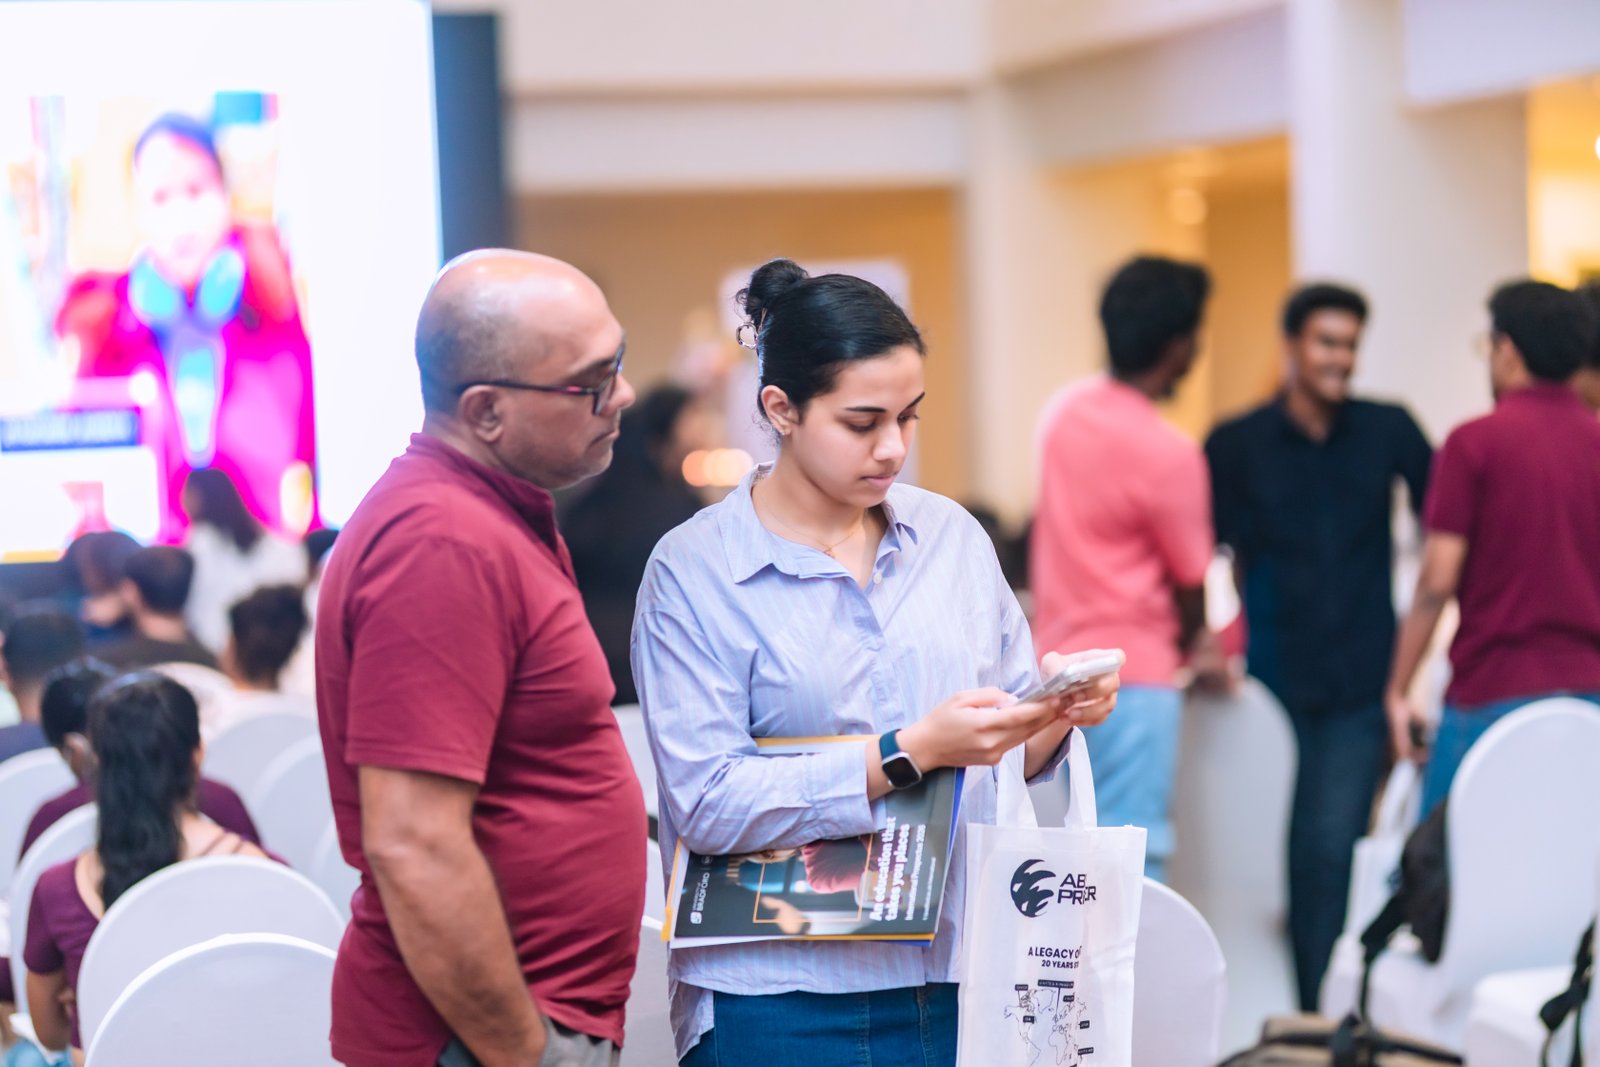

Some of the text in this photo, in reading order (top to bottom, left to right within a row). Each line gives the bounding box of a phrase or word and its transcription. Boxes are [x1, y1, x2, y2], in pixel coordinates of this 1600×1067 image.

[869, 816, 896, 921] An education that
[885, 823, 910, 921] takes you places
[697, 872, 710, 911] BRADFORD
[1028, 946, 1033, 956] A
[1035, 947, 1074, 959] LEGACY
[1041, 959, 1051, 967] 20
[1052, 960, 1074, 969] YEARS
